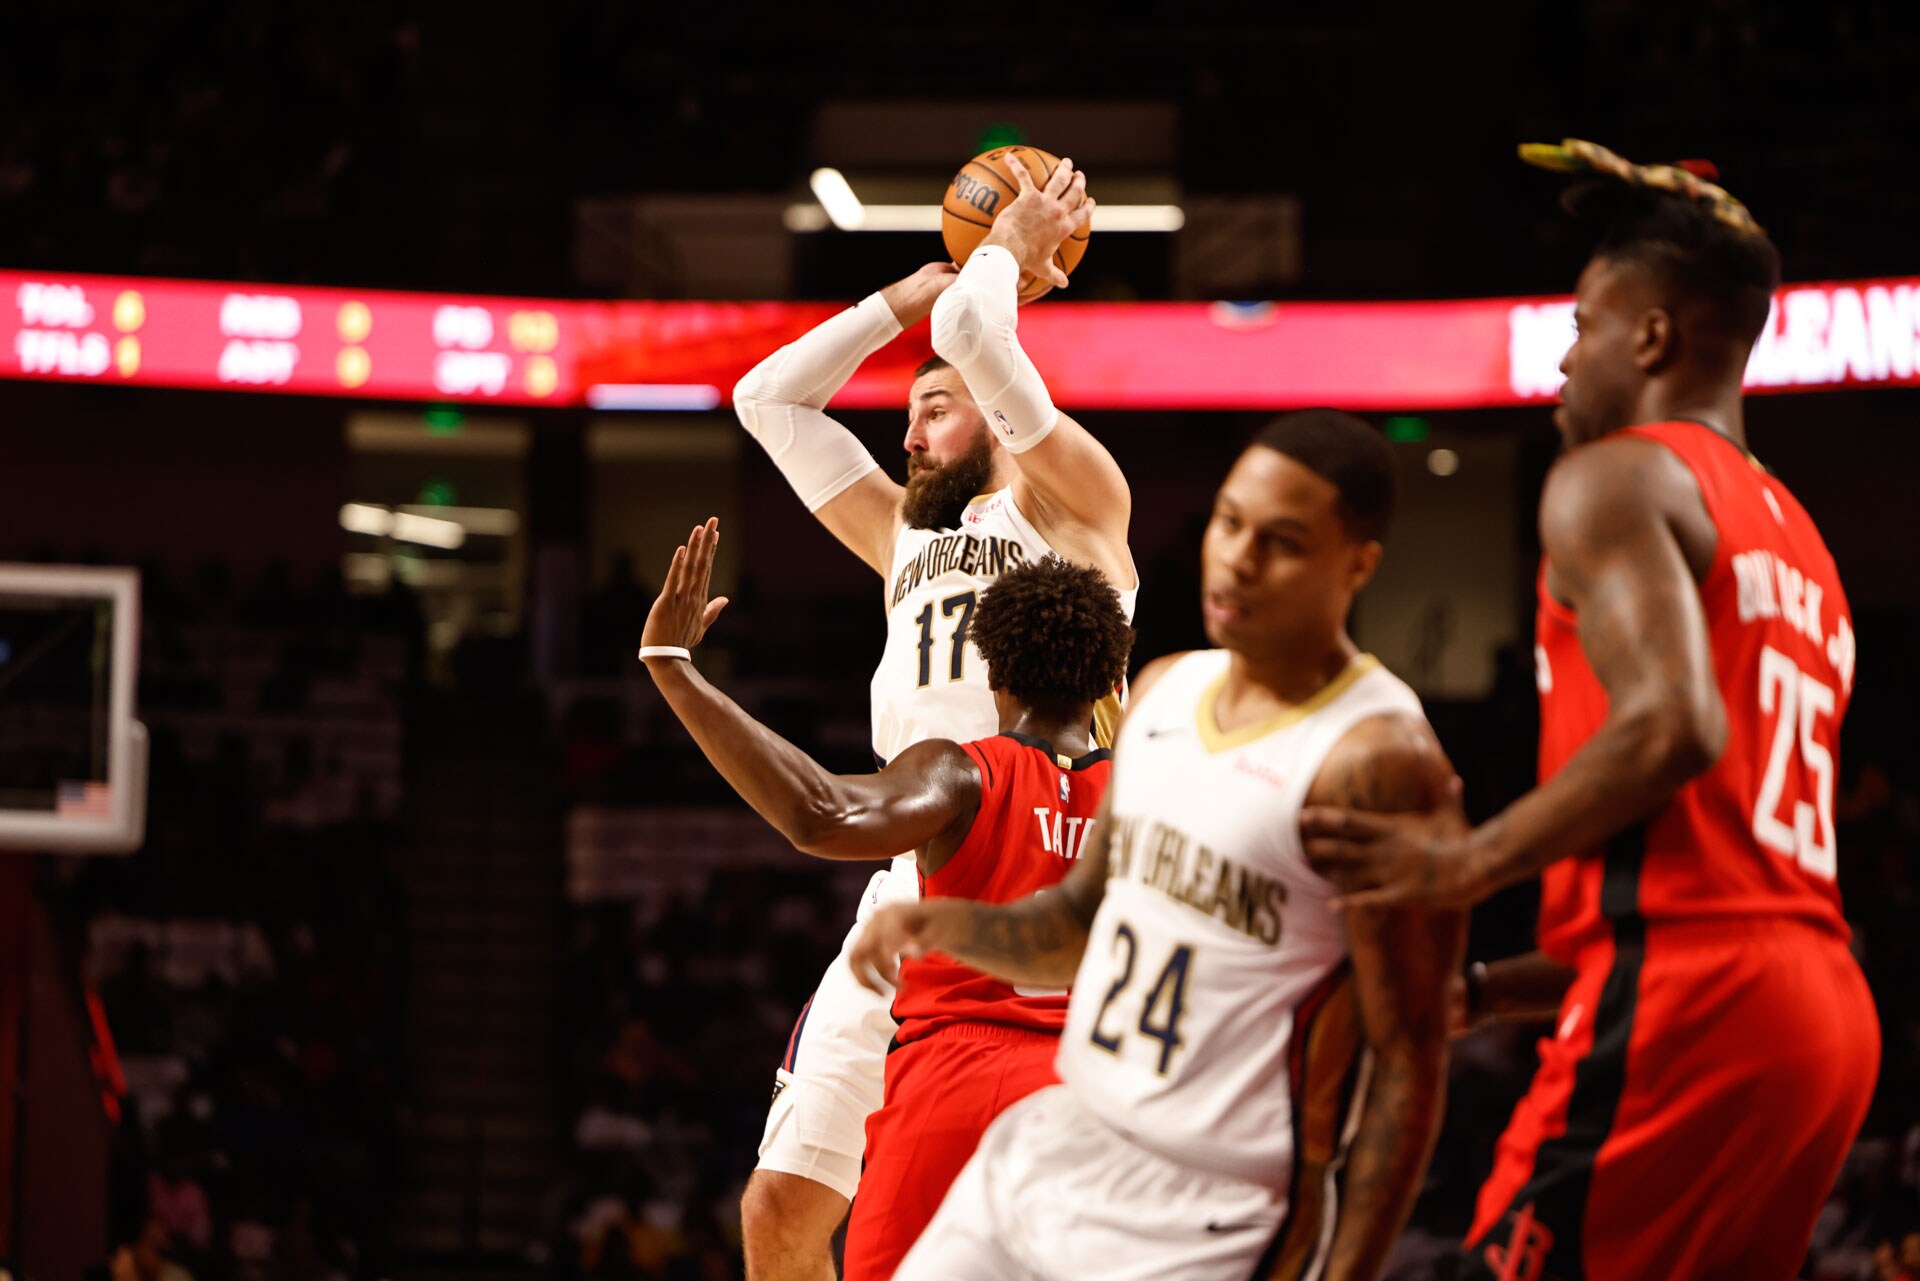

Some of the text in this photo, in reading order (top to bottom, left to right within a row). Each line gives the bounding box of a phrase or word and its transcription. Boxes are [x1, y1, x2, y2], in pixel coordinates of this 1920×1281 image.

[951, 171, 1000, 217] Wils
[891, 533, 1024, 609] NEW ORLEANS
[914, 588, 980, 690] 17
[1752, 644, 1837, 880] 25
[1088, 921, 1197, 1078] 24
